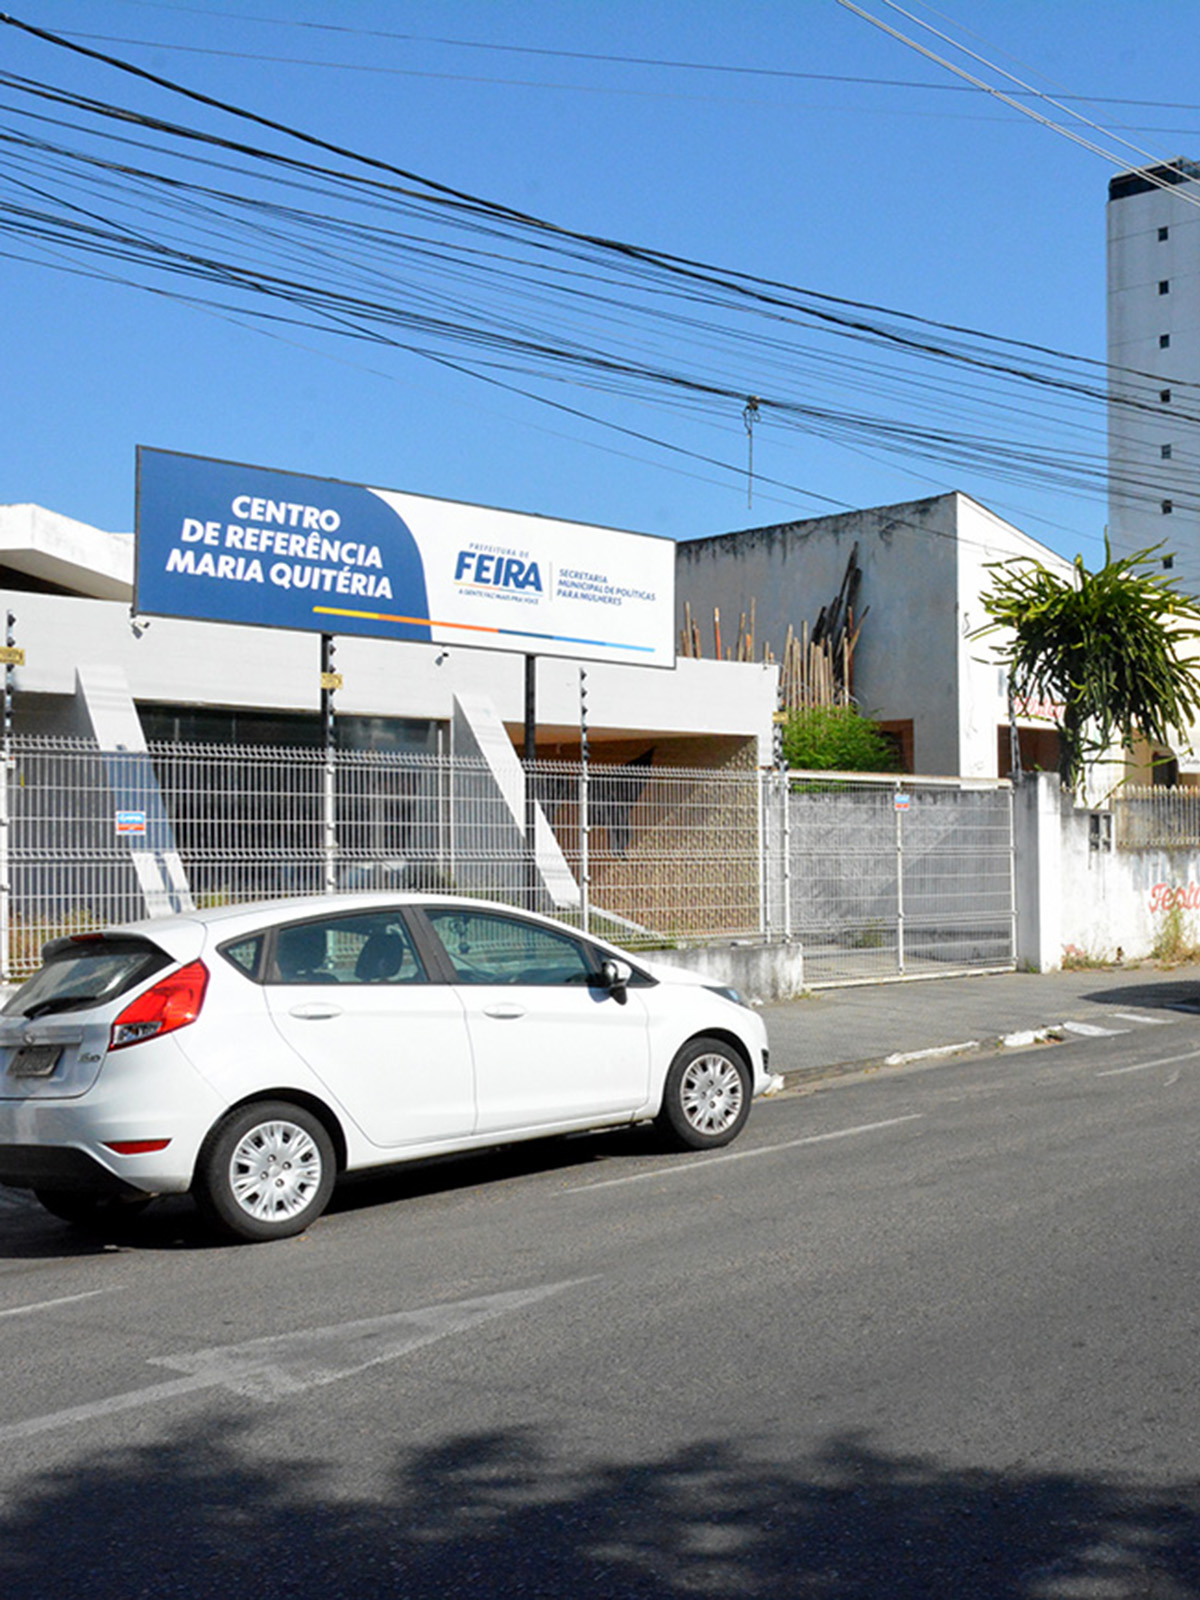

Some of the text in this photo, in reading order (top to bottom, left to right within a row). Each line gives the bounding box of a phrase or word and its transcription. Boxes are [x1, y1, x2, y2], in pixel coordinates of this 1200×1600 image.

[231, 494, 341, 532] CENTRO
[181, 517, 383, 569] DE REFERÊNCIA
[165, 548, 393, 599] MARIA QUITÉRIA
[454, 550, 543, 592] FEIRA
[557, 579, 602, 594] MUNICIPAL
[604, 585, 614, 596] DE
[558, 568, 608, 583] SECRETARIA
[556, 588, 622, 607] PARA MULHERES
